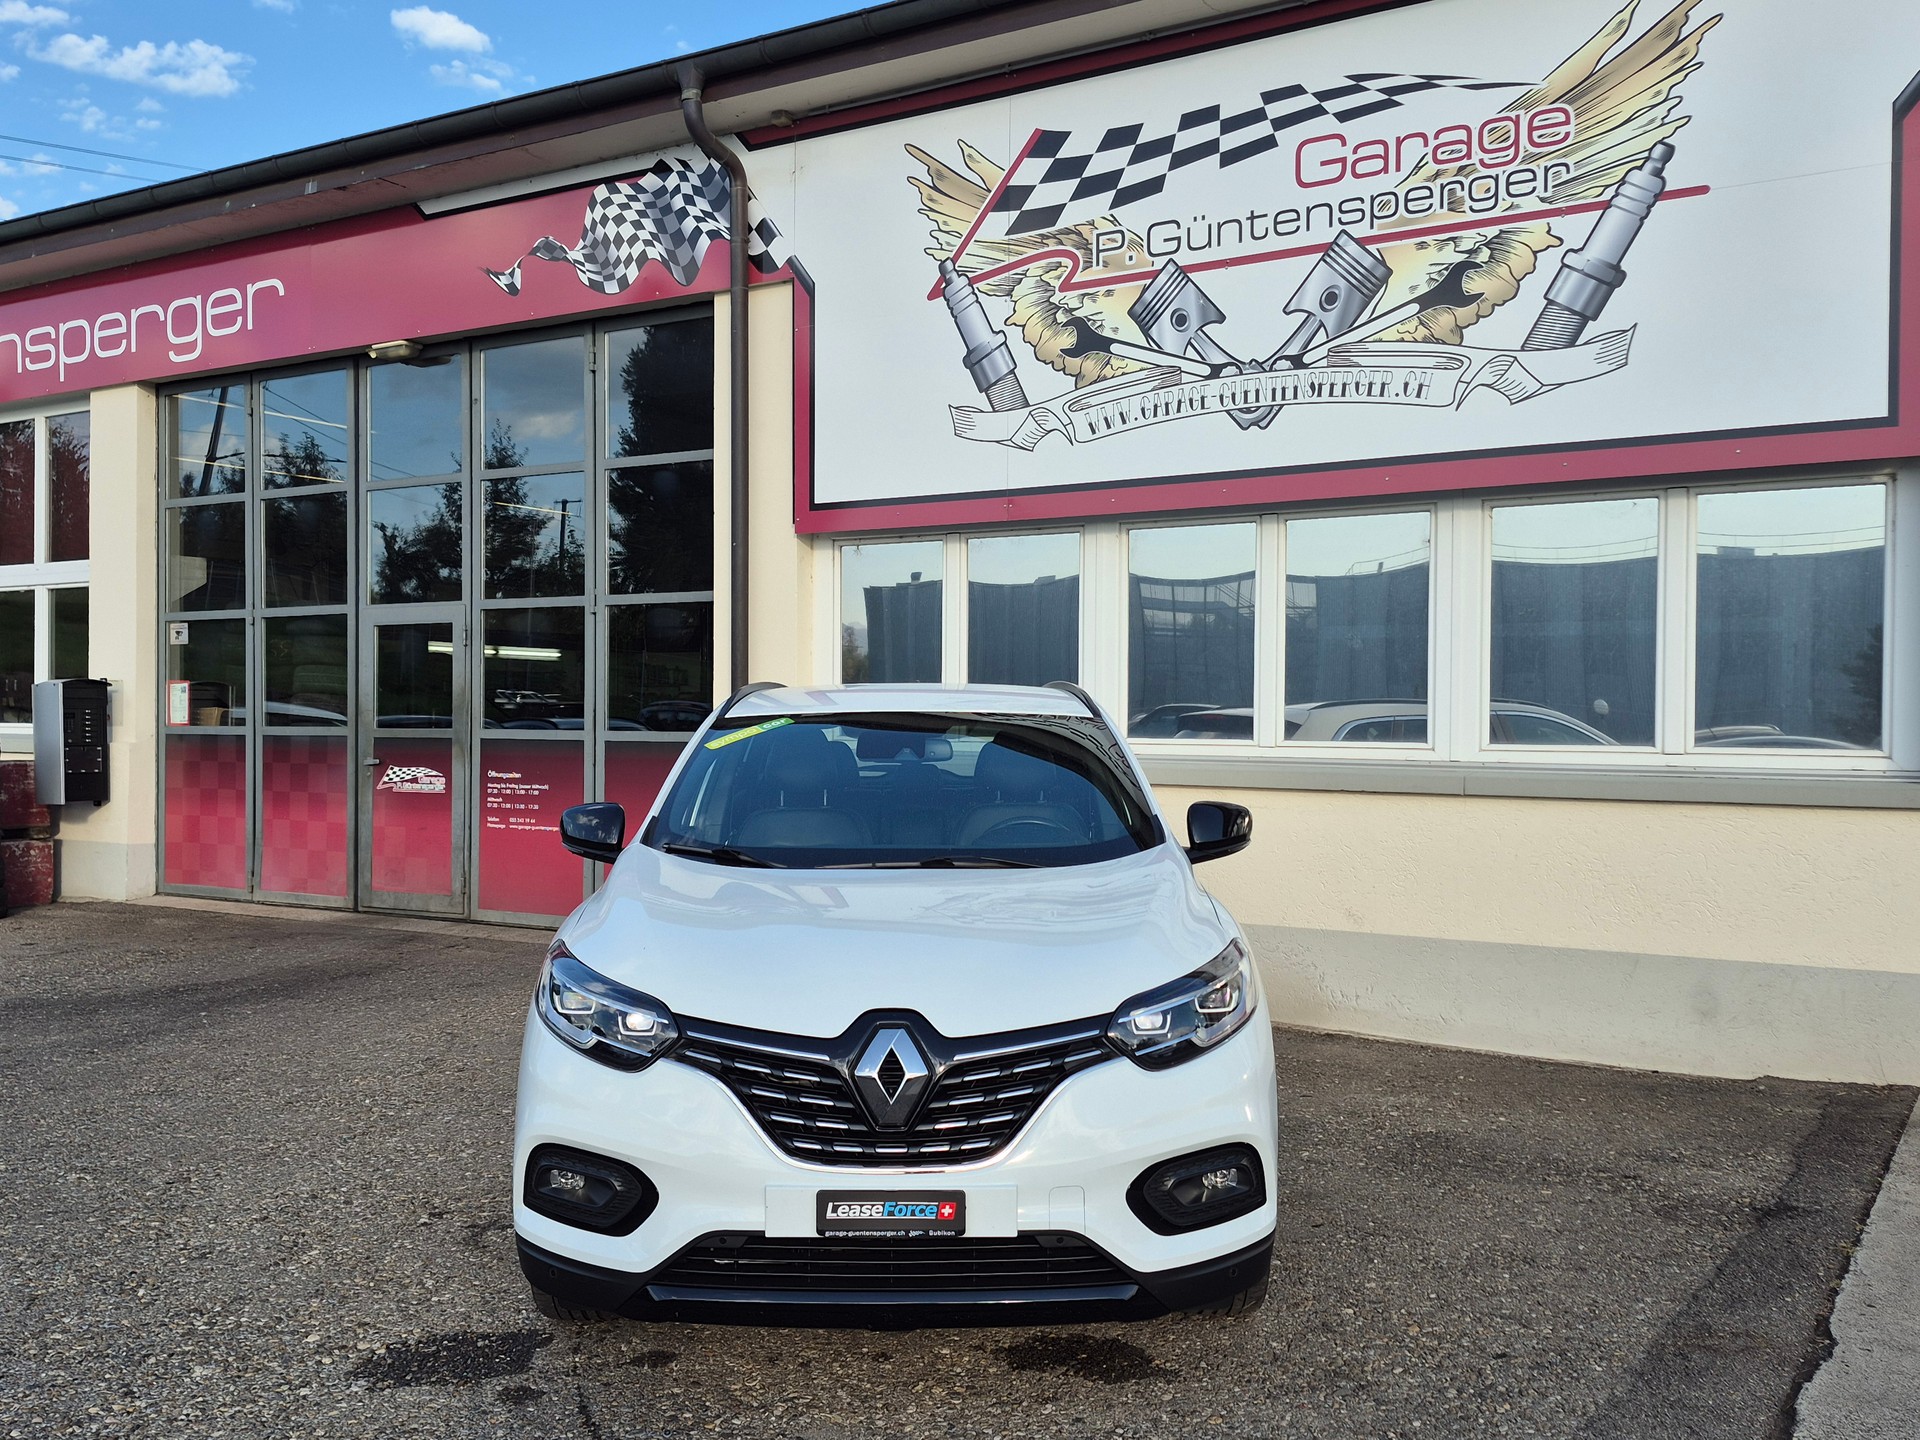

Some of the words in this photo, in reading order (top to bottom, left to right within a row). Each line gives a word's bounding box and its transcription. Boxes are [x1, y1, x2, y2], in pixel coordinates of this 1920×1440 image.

[1293, 104, 1575, 190] Garage
[1146, 162, 1573, 258] Güntensperger
[1084, 370, 1434, 436] WWW.GARAGE-GUENTENSPERGER.CH
[826, 1202, 938, 1217] LeaseForce
